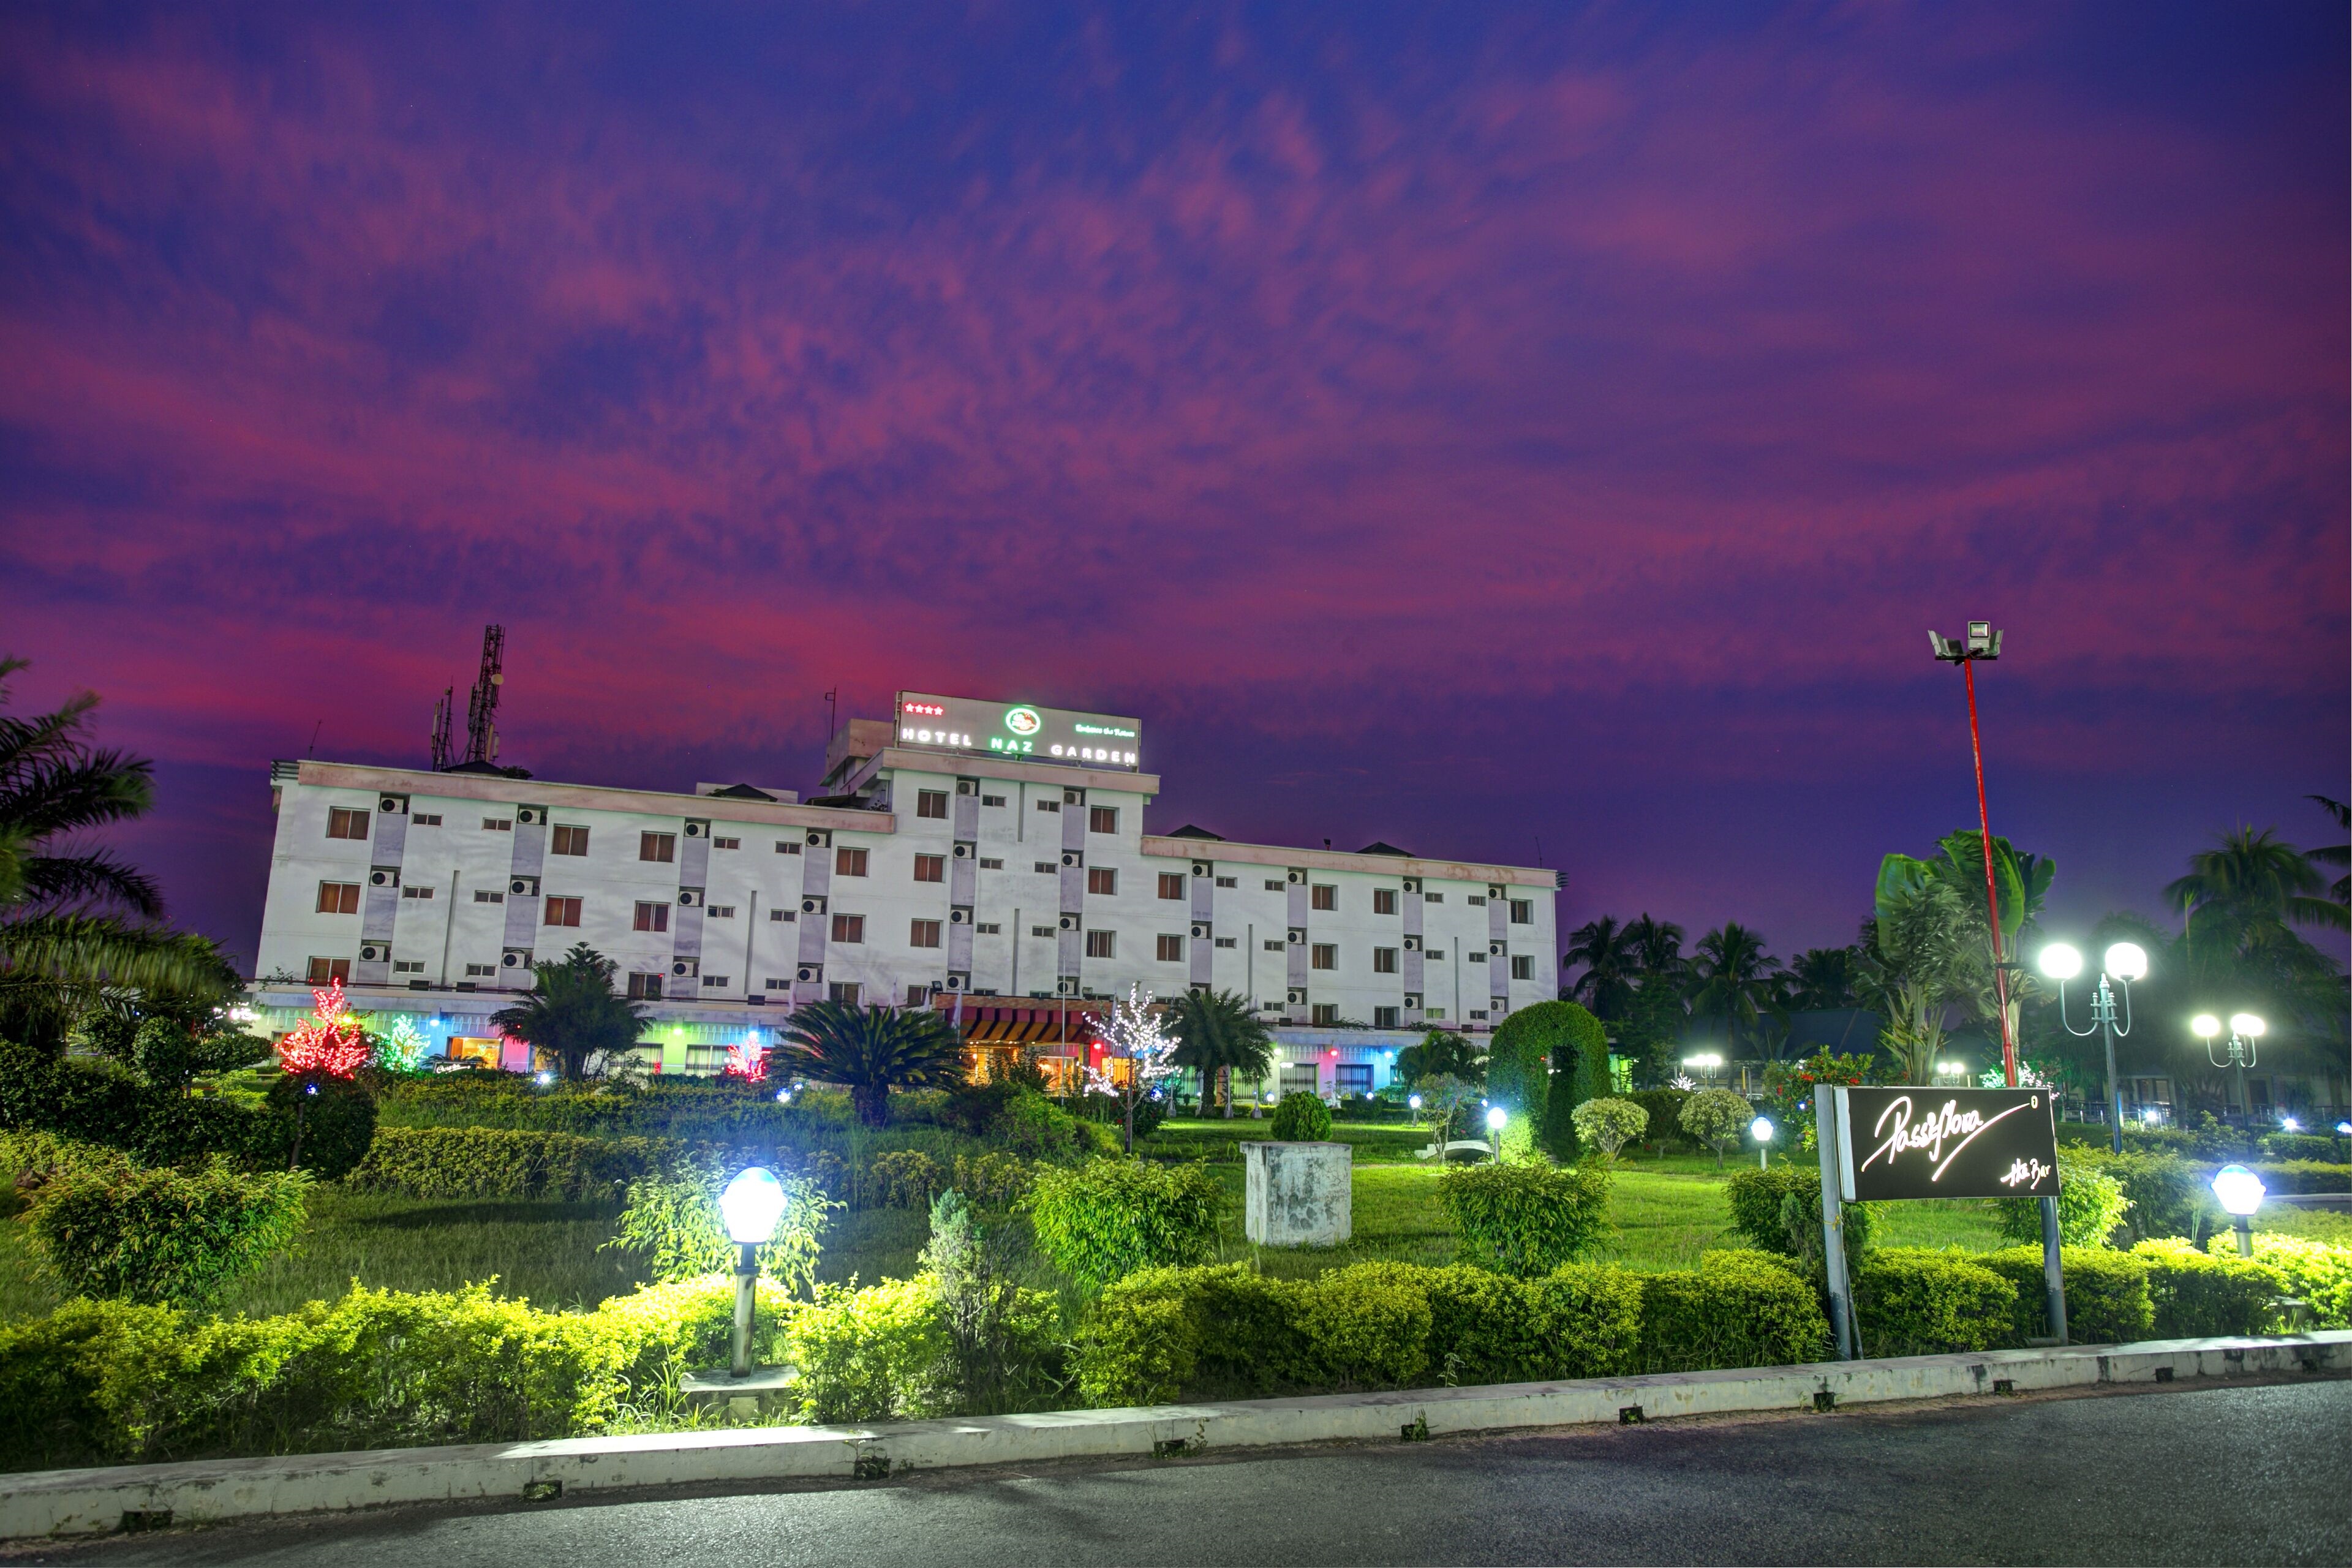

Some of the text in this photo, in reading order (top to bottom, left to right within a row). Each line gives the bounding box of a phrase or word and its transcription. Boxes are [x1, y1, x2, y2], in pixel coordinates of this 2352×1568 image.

[902, 728, 1136, 764] HOTEL NAZ GARDEN
[1861, 1095, 1985, 1172] Passiflora
[2029, 1158, 2051, 1190] Bar
